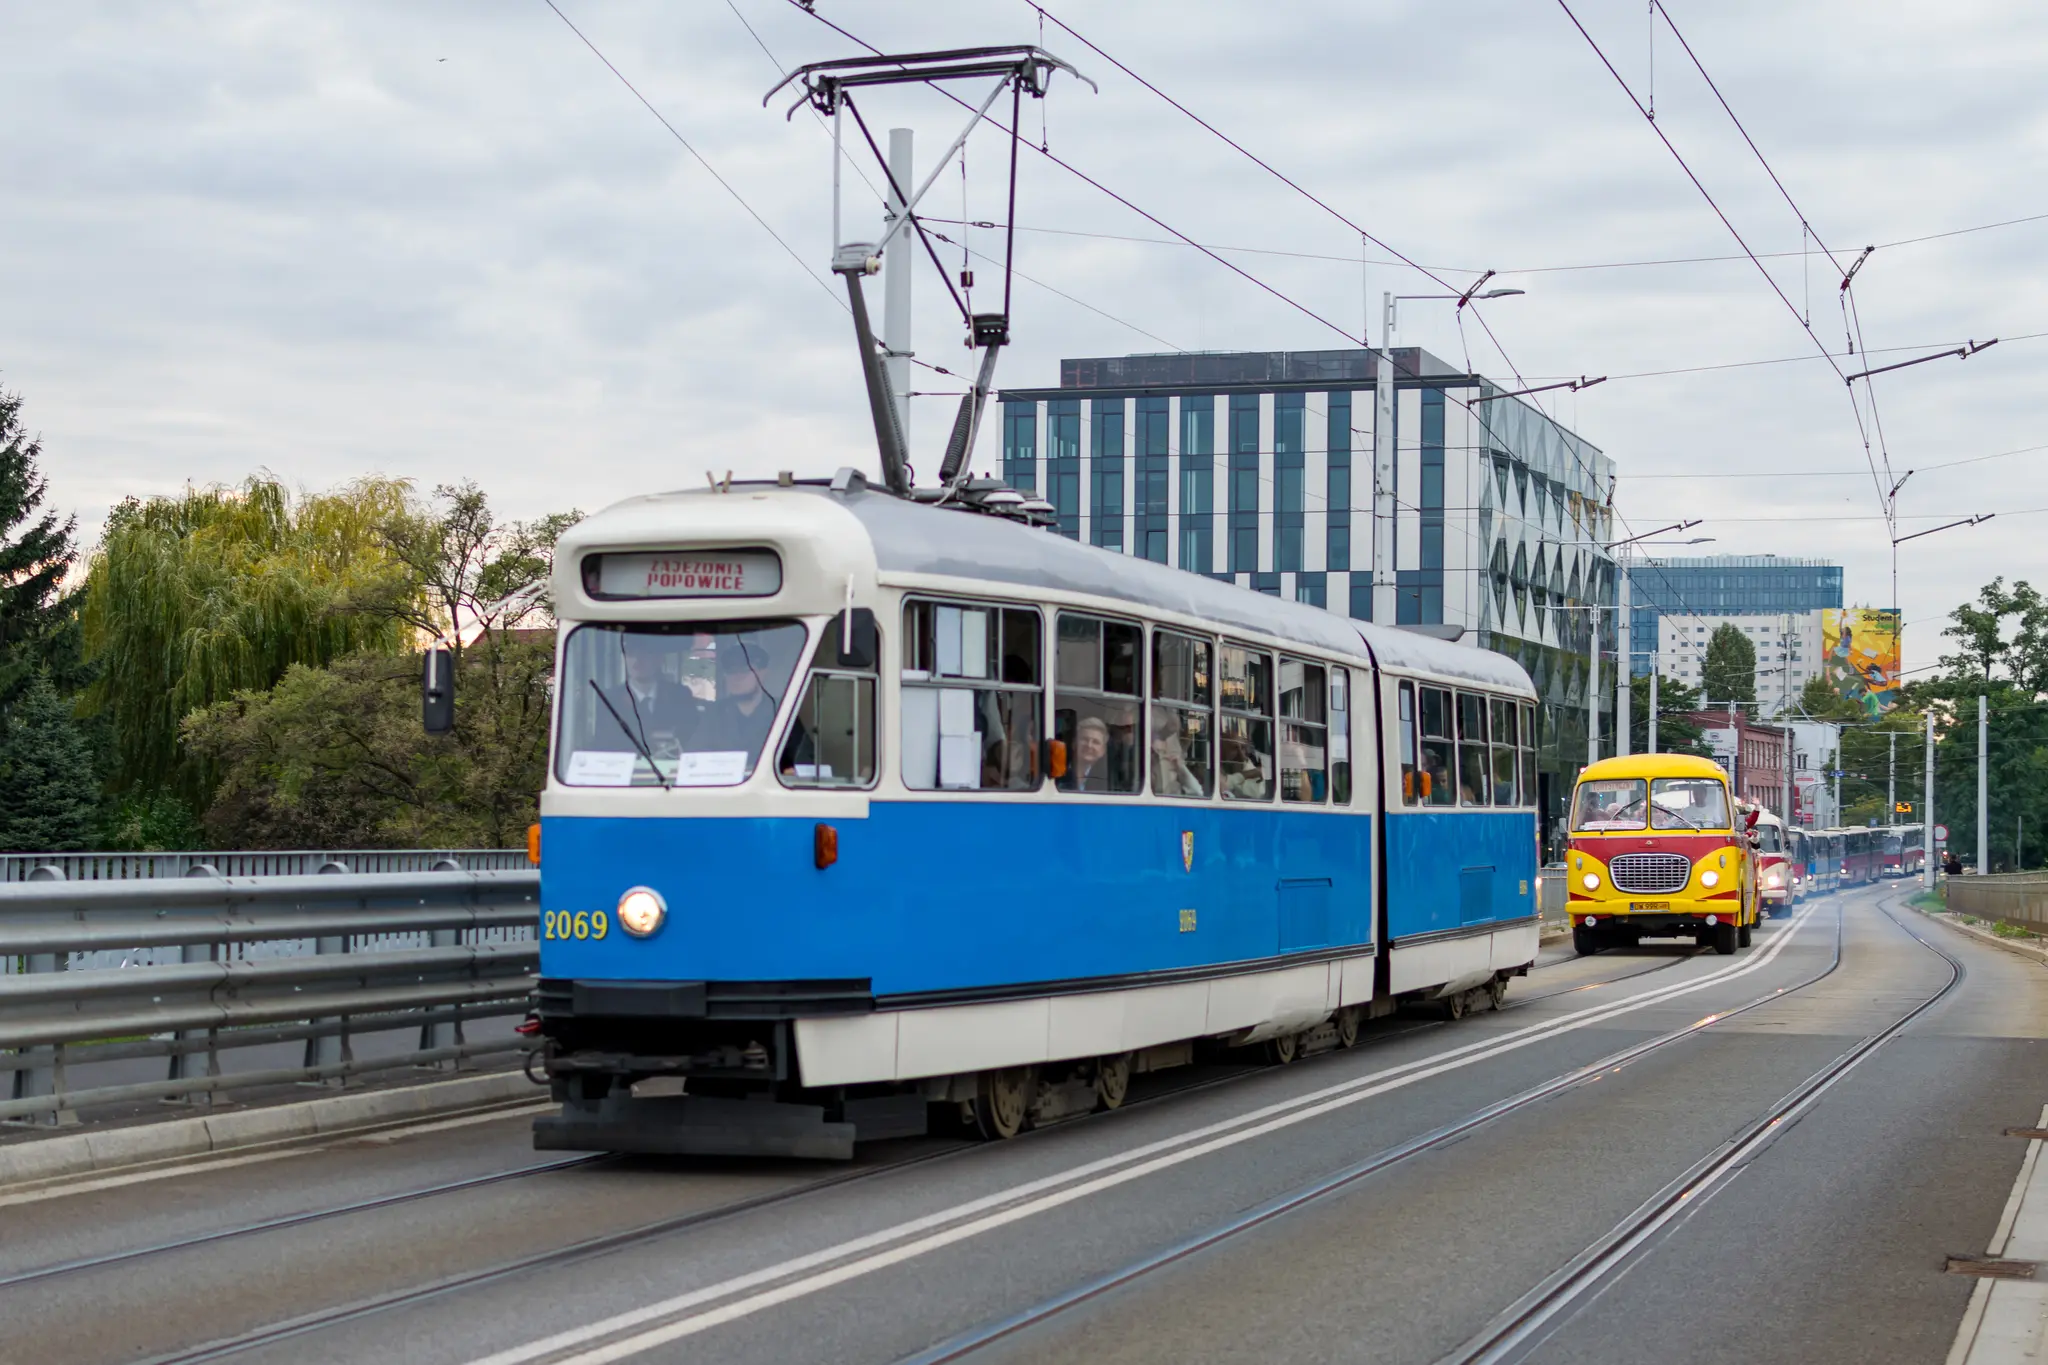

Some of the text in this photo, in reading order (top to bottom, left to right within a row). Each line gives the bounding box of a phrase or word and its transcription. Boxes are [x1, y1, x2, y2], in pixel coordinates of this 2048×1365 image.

[651, 559, 743, 575] ZAJEZDNIA
[647, 573, 744, 590] POPOWICE
[1862, 614, 1893, 622] Student
[544, 910, 608, 940] 2069
